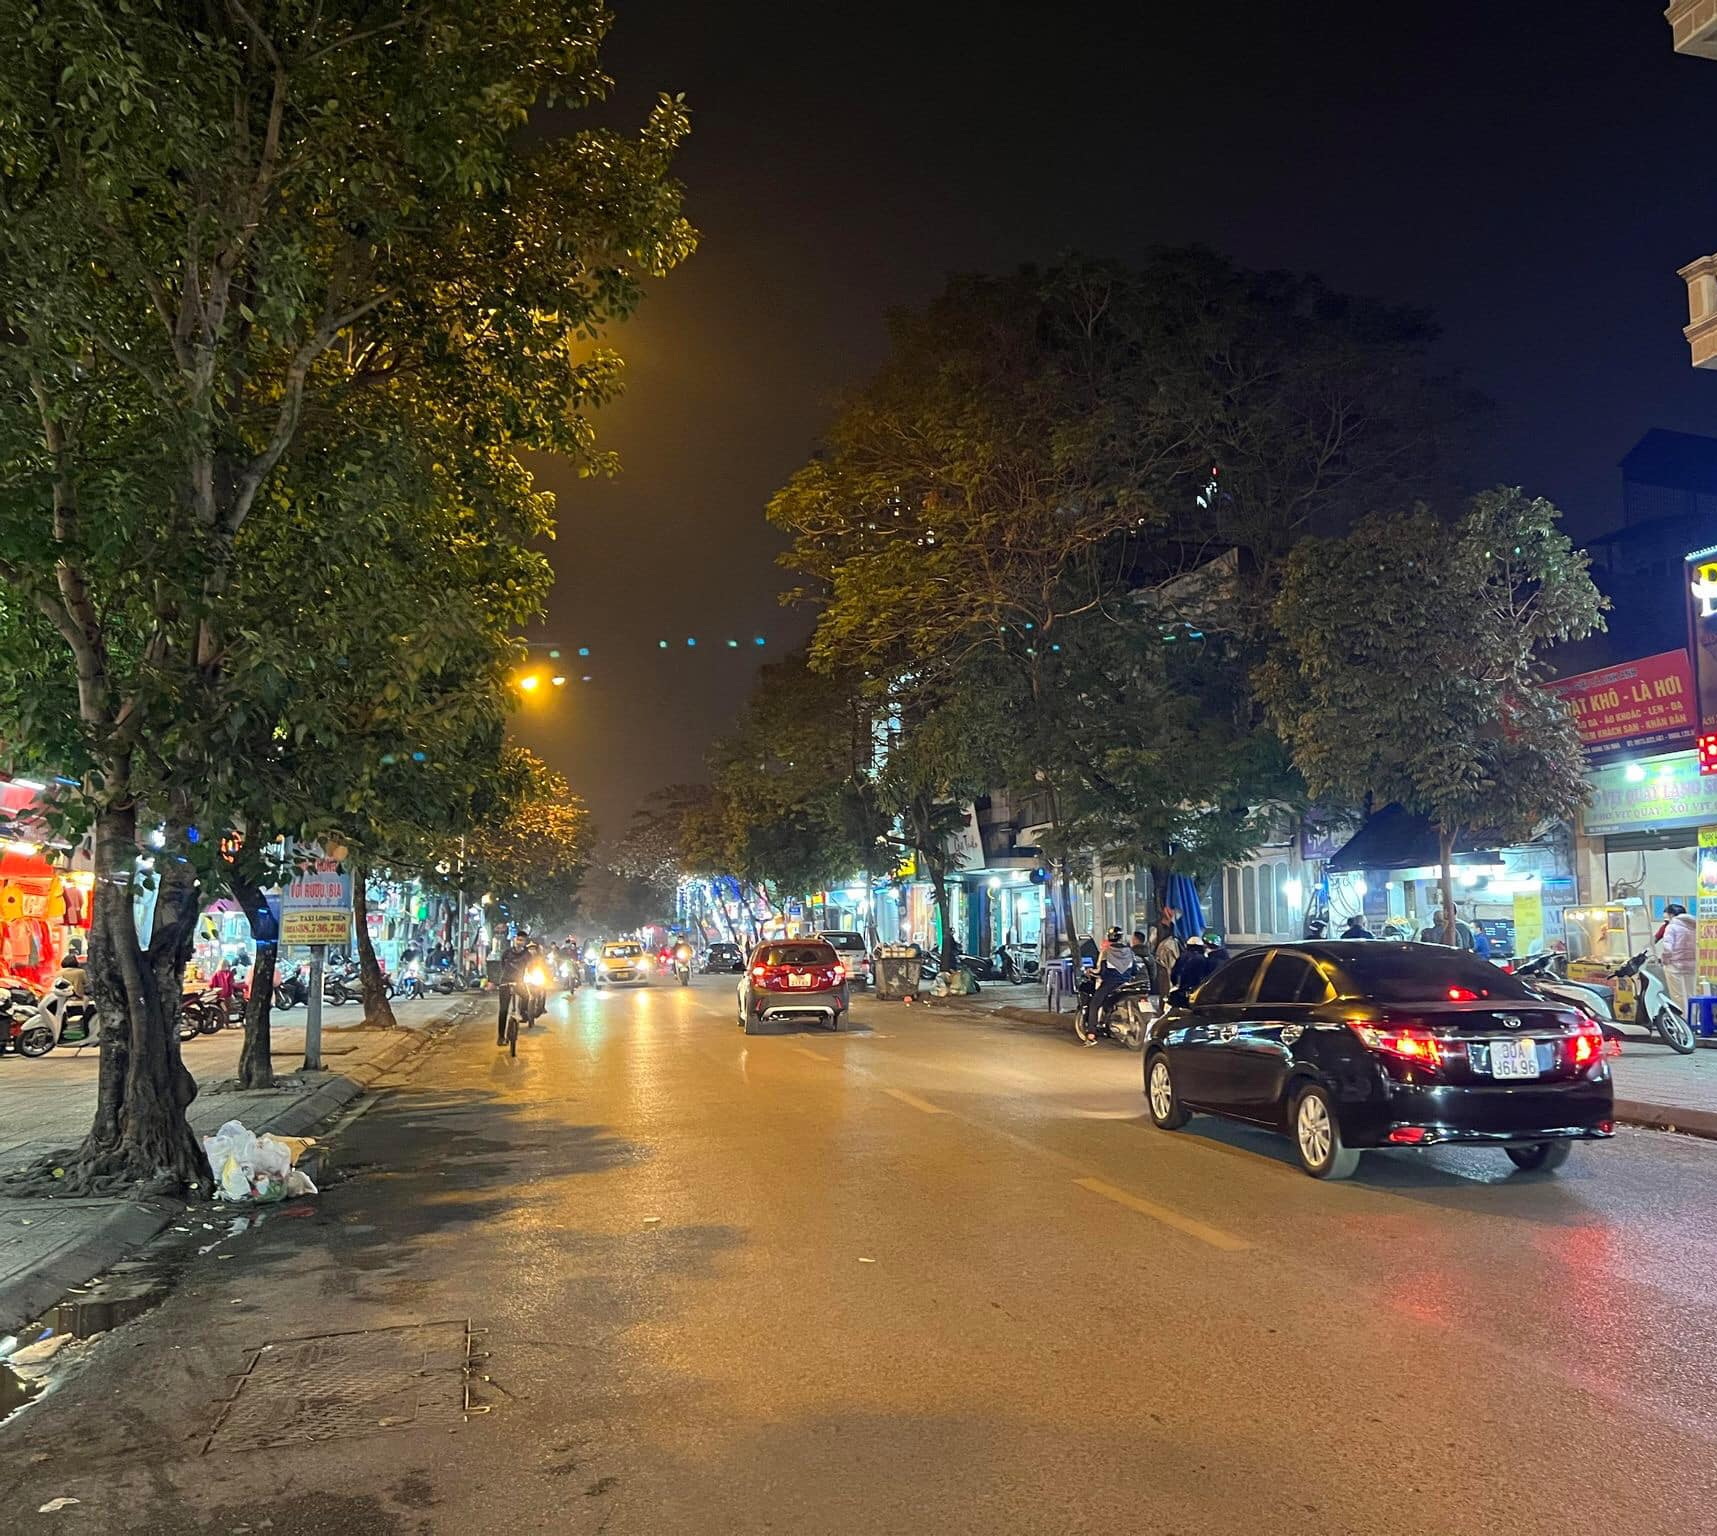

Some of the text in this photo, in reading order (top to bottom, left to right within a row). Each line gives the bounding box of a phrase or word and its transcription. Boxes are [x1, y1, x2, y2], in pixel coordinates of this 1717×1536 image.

[1590, 688, 1620, 712] KHÔ
[1632, 680, 1652, 703] LÀ
[1654, 675, 1683, 696] HƠI
